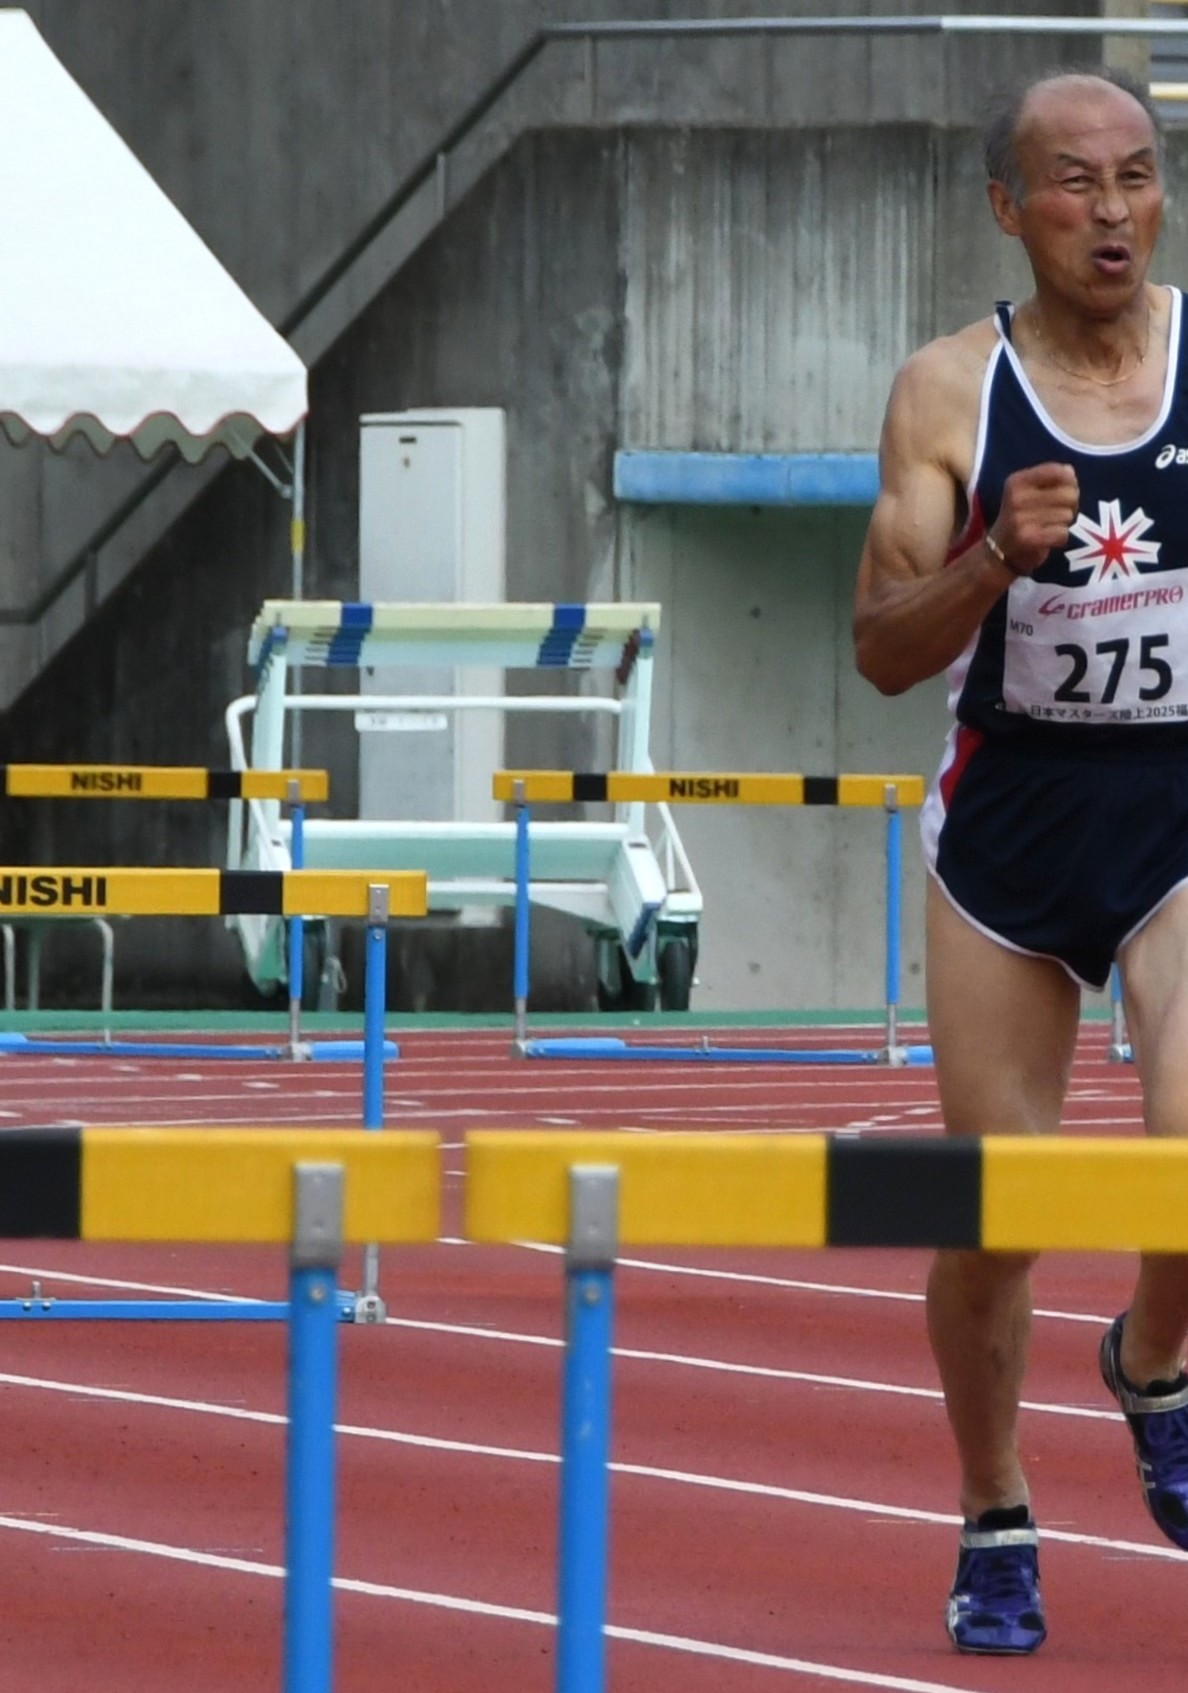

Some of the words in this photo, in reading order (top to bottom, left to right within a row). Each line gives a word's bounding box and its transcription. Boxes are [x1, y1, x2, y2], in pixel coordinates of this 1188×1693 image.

[1009, 618, 1034, 637] M70
[1054, 633, 1173, 704] 275
[71, 772, 142, 791] NISHI
[669, 778, 739, 798] NISHI
